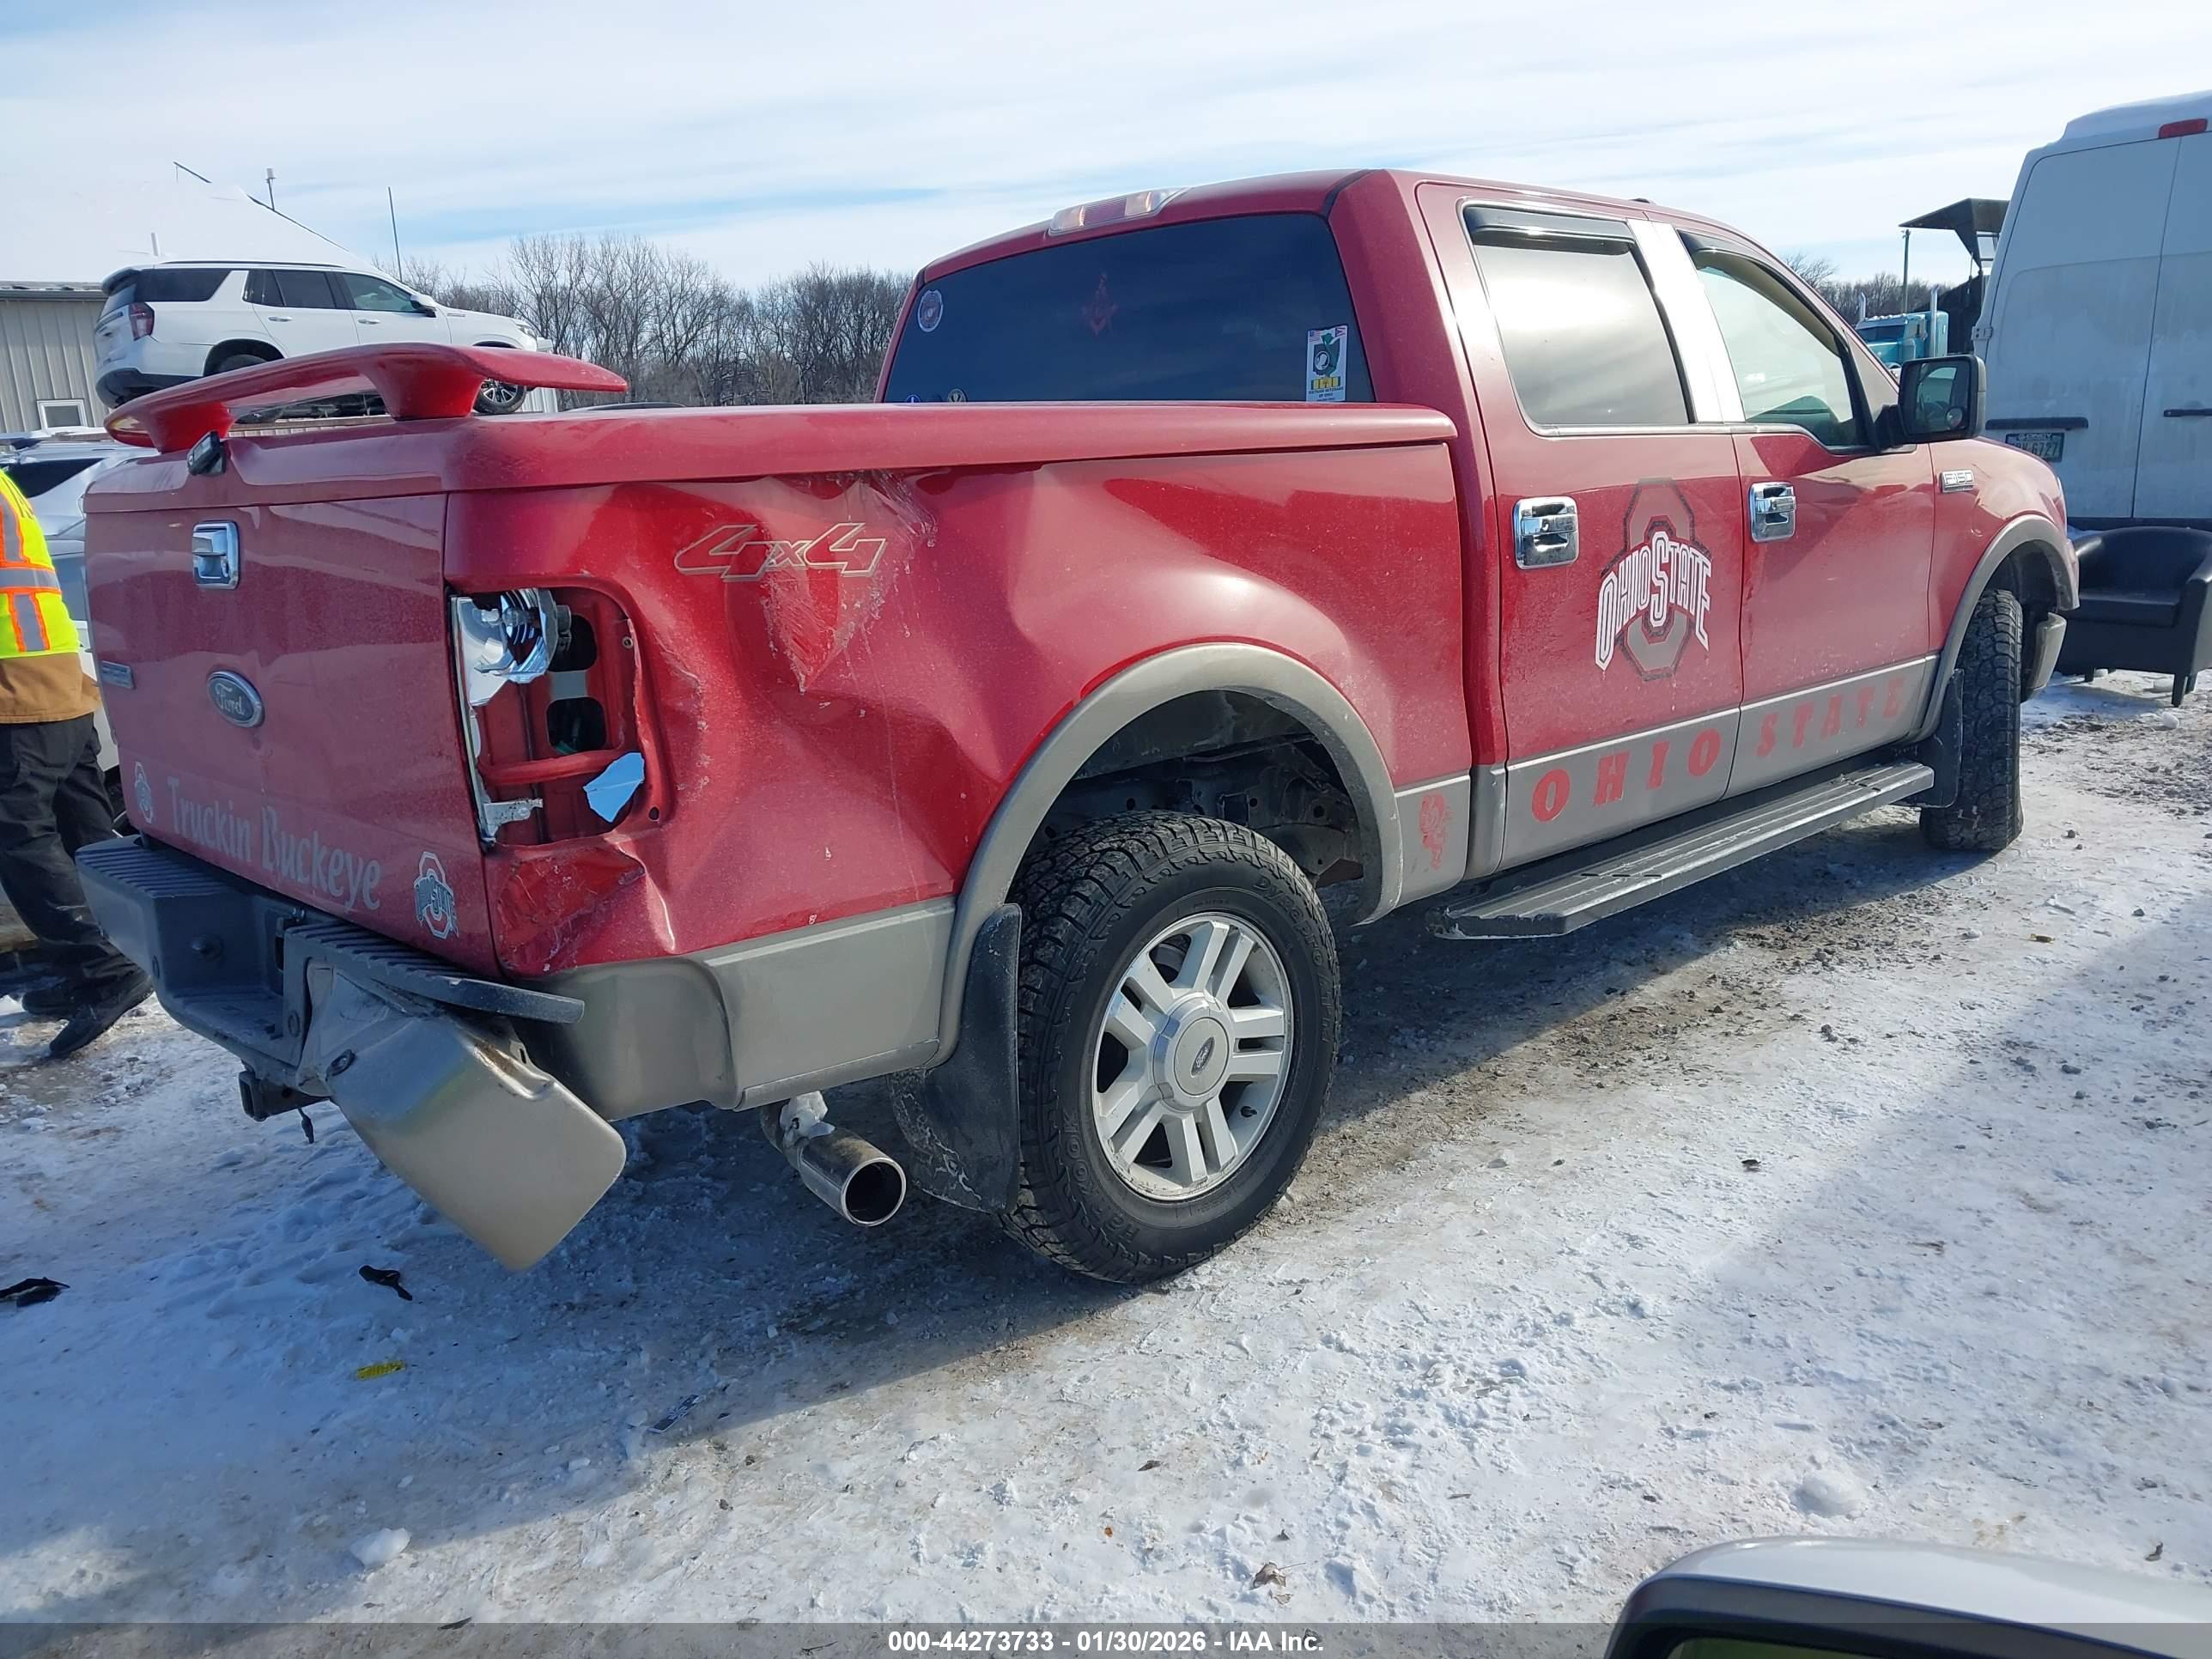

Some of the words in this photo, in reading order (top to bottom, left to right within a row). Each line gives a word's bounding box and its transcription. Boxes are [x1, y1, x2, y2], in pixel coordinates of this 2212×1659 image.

[674, 522, 888, 581] 4x4
[1531, 727, 1722, 823] OHIO
[1756, 678, 1906, 758] STATE
[167, 775, 252, 863] Truckin
[261, 805, 380, 915] Buckeye
